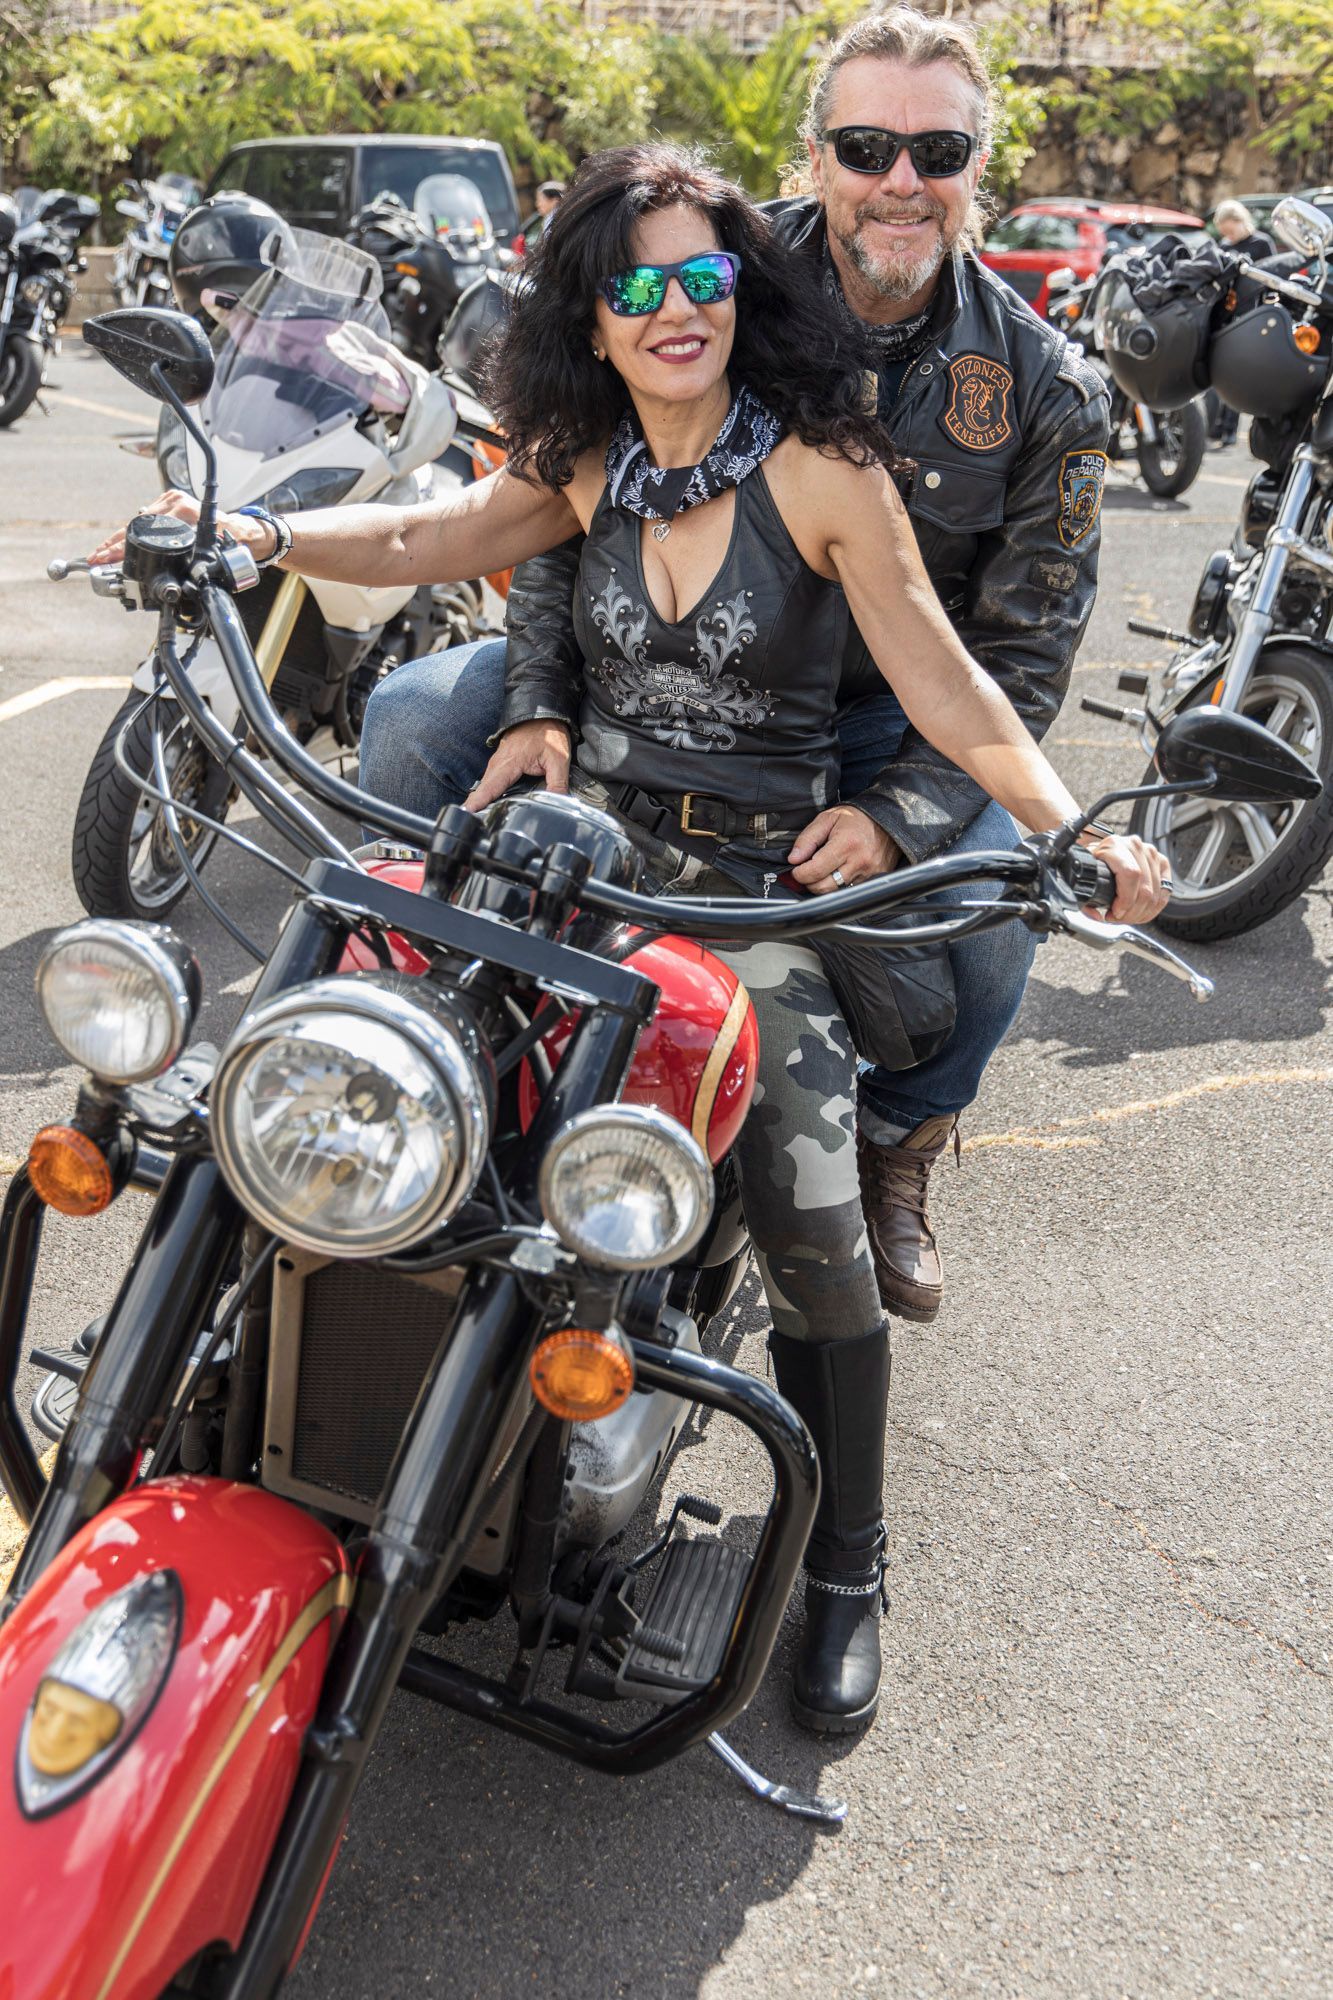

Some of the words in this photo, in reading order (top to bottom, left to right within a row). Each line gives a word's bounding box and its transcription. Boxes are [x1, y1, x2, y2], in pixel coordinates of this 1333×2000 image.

[955, 361, 1009, 390] TIZONES
[949, 411, 1006, 445] TENERIFE
[1080, 455, 1104, 467] POLICE
[1064, 492, 1072, 515] CITY
